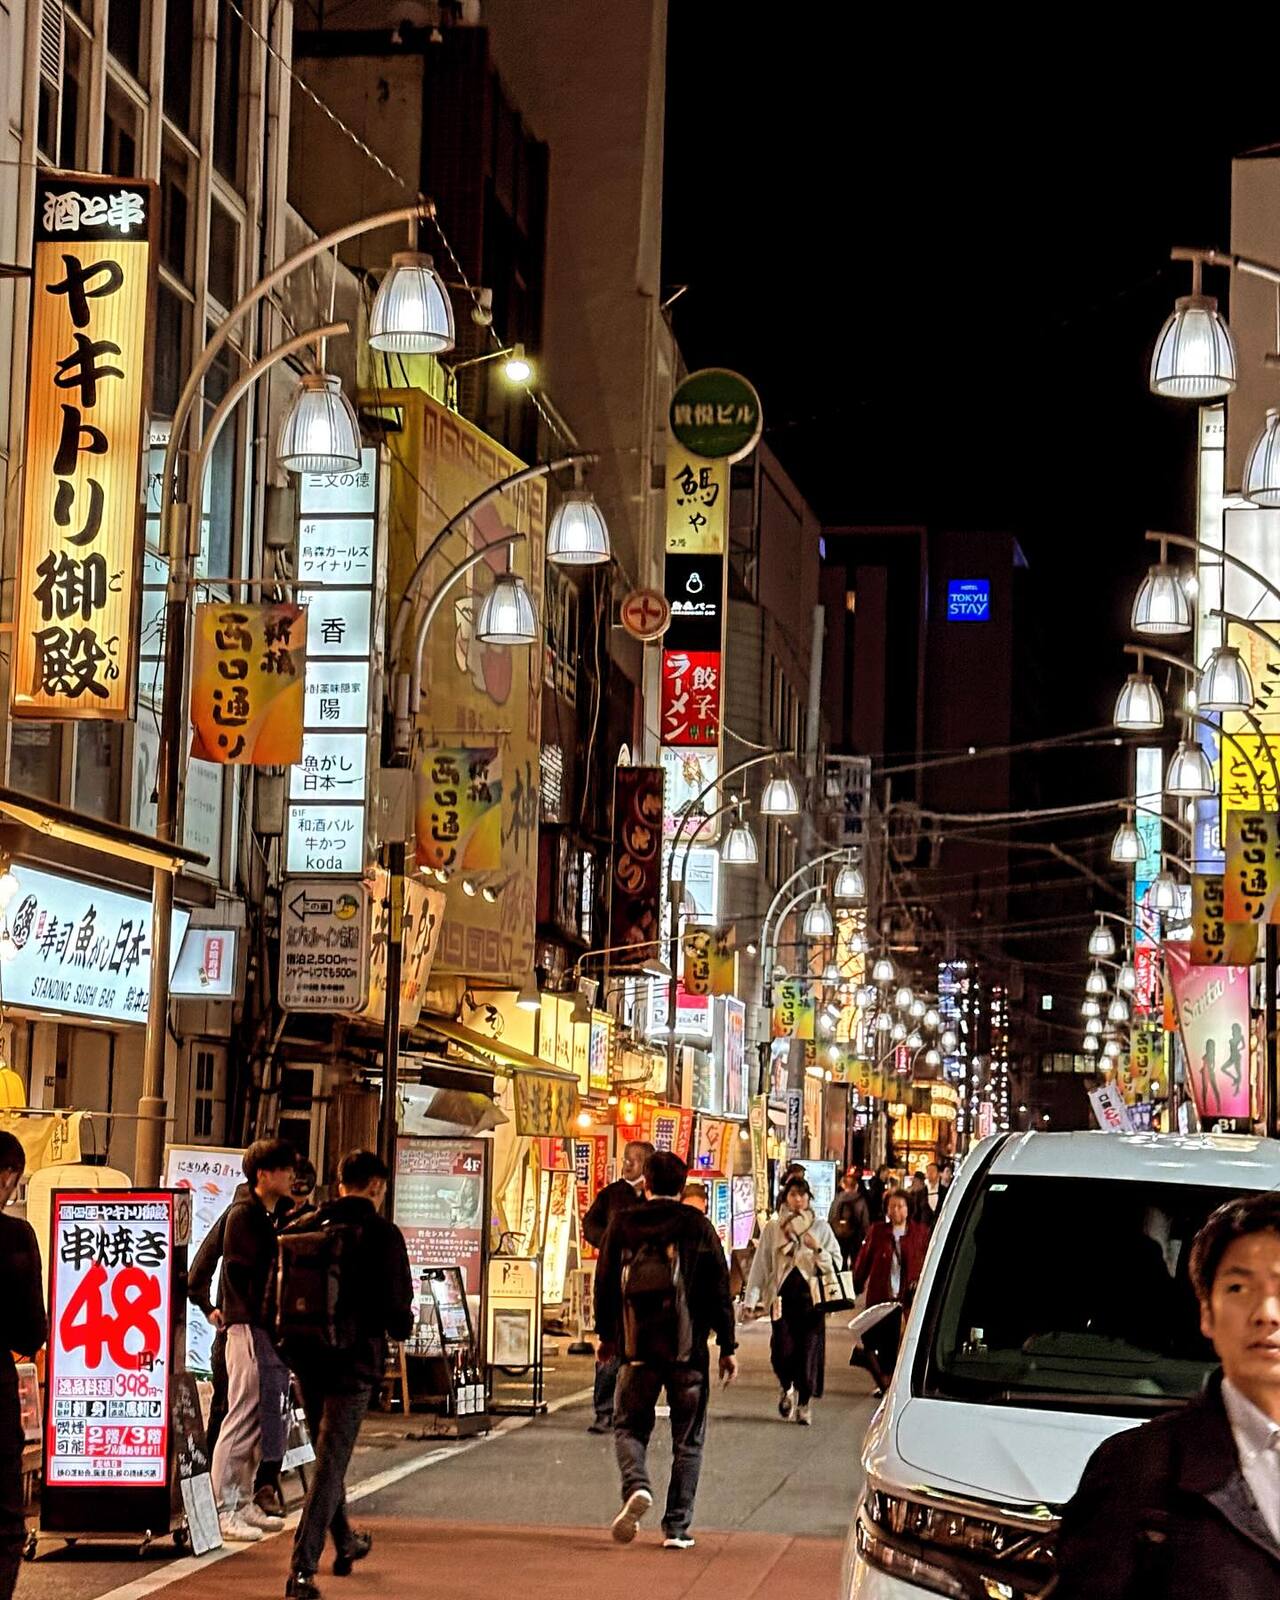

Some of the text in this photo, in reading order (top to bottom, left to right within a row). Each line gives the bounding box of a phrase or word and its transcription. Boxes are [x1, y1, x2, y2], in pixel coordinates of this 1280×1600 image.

[43, 189, 145, 233] 酒と串
[33, 253, 125, 701] ヤキトリ御殿
[303, 525, 316, 534] 4F
[303, 560, 367, 572] ワイナリー
[950, 593, 988, 602] TOKYU
[949, 603, 988, 615] STAY
[320, 618, 346, 643] 香
[212, 612, 253, 759] 西口通り
[692, 666, 717, 720] 餃子
[664, 653, 691, 741] ラーメン
[320, 698, 341, 720] 陽
[304, 755, 353, 771] 魚がし
[303, 774, 354, 791] 日本一
[431, 756, 460, 867] 西口通り
[298, 819, 354, 832] 和酒バル
[305, 837, 346, 851] 牛かつ
[306, 855, 343, 870] koda
[31, 976, 72, 1001] STANDING
[74, 984, 98, 1006] SUSHI
[98, 988, 115, 1009] BAR
[463, 1157, 481, 1171] 4F
[61, 1224, 168, 1271] 串焼き
[58, 1421, 84, 1435] 喫煙
[58, 1440, 84, 1454] 可能
